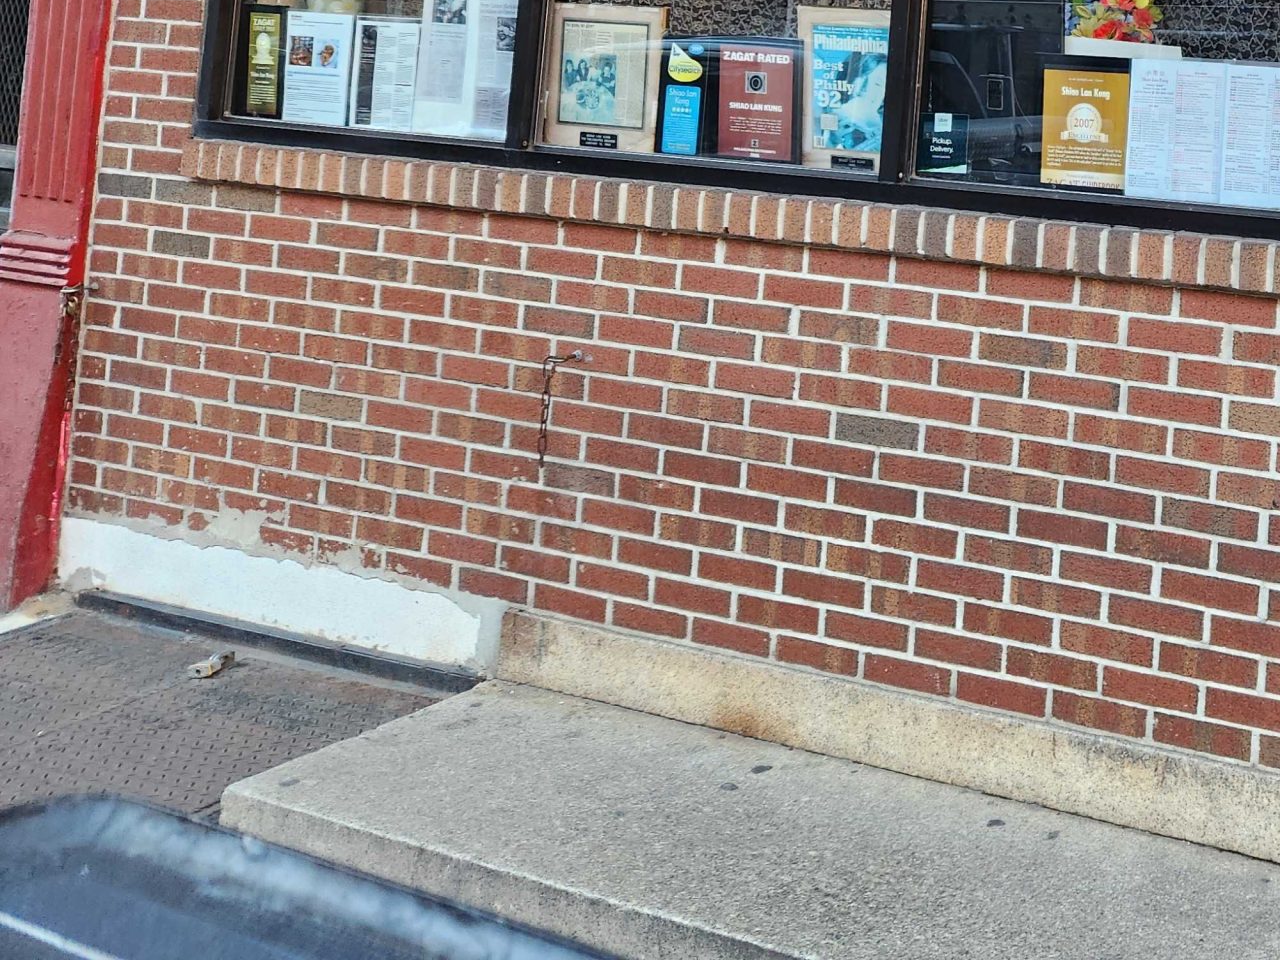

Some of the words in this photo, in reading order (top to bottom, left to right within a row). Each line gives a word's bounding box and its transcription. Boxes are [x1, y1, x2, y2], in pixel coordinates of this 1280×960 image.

[813, 33, 888, 54] Philadelphia
[723, 50, 756, 62] ZAGAT
[757, 53, 790, 65] RATED
[813, 59, 844, 72] Best
[823, 71, 836, 80] of
[813, 79, 855, 96] Philly
[1061, 85, 1080, 97] Shiao
[1080, 87, 1093, 97] Lan
[729, 101, 750, 110] SHIAO
[750, 103, 763, 111] LAN
[763, 104, 783, 113] KUNG
[1073, 118, 1095, 129] 2007
